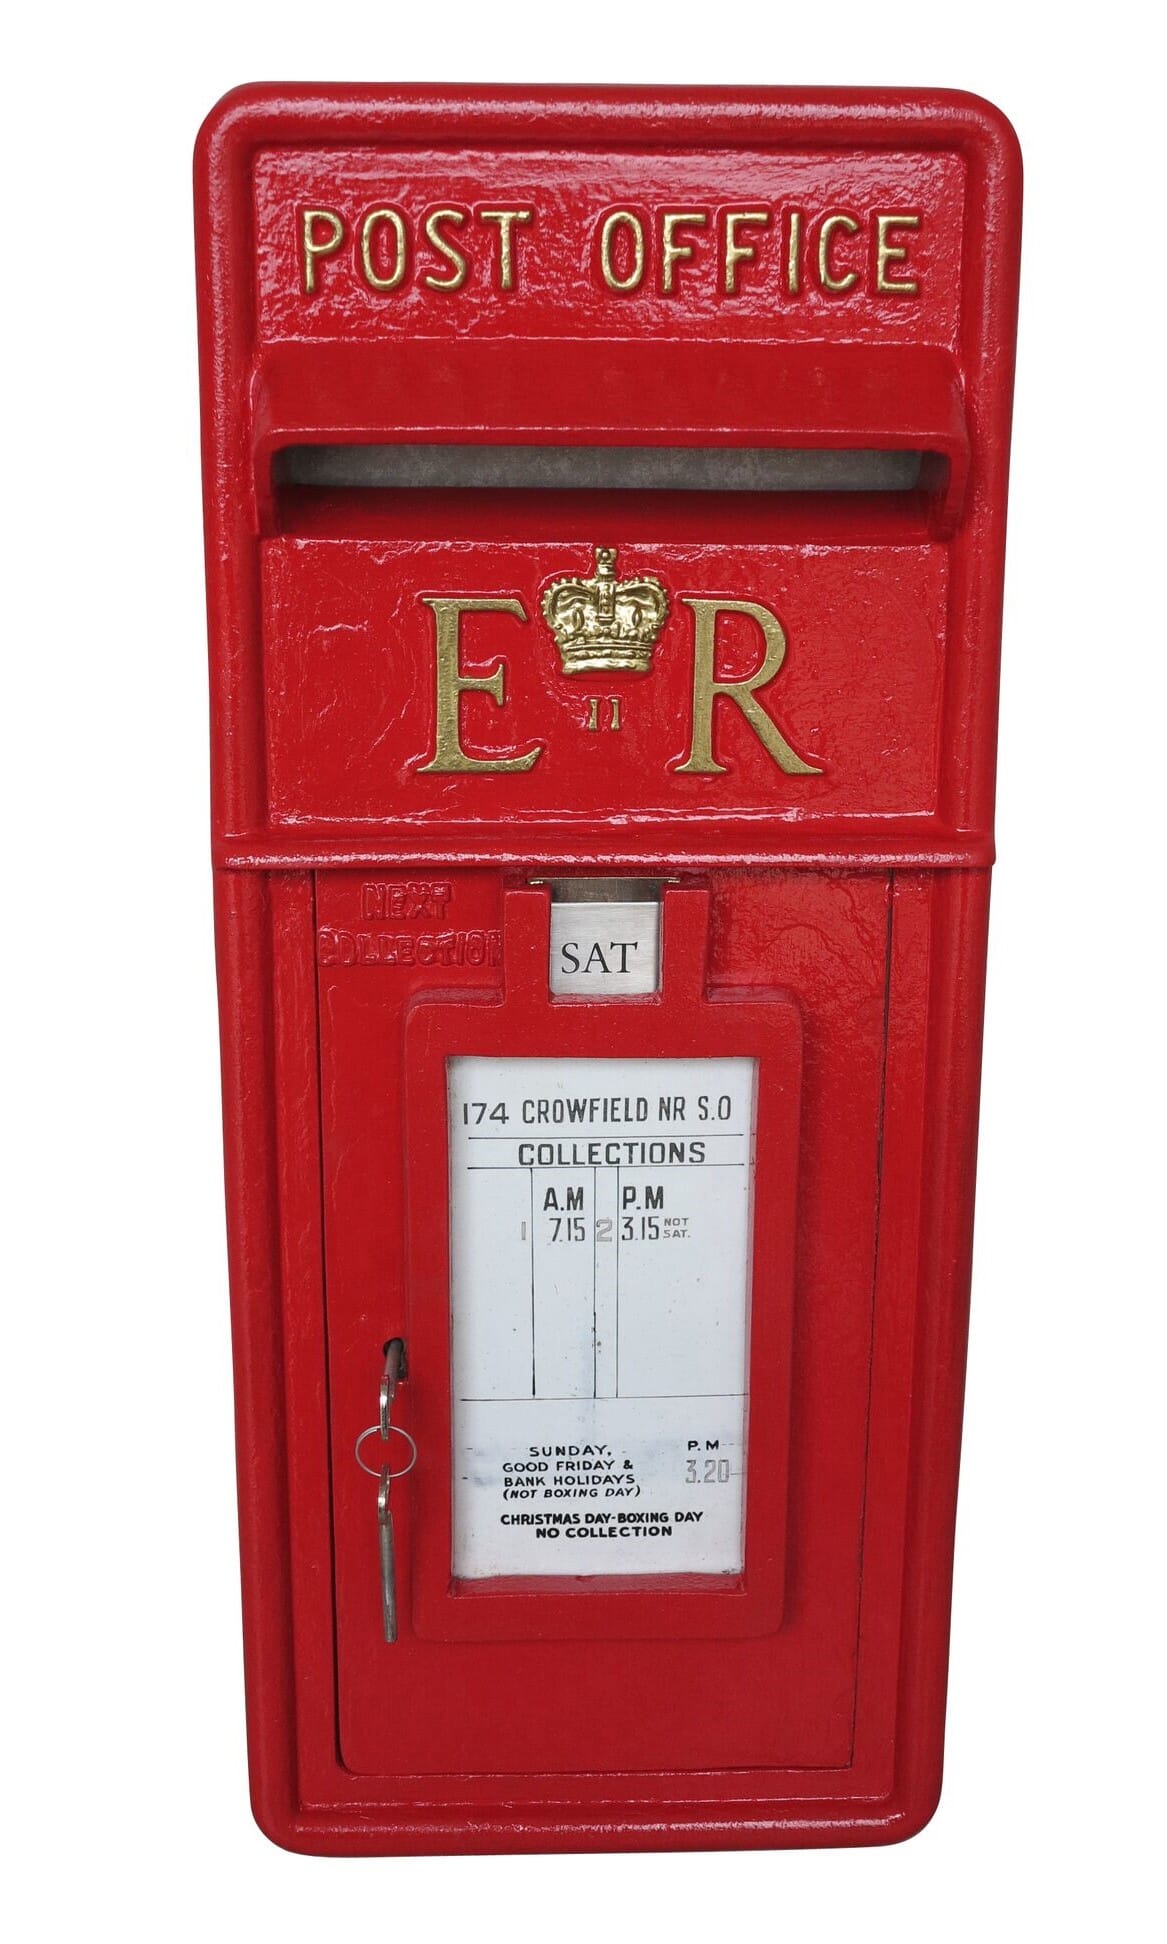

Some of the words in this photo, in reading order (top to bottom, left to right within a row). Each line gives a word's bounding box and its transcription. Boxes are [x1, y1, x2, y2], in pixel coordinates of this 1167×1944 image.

[303, 208, 532, 295] POST
[600, 209, 922, 295] OFFICE
[417, 597, 544, 776] E
[674, 597, 824, 777] R
[360, 882, 451, 921] NEXT
[561, 942, 639, 975] SAT
[462, 1102, 510, 1125] 174
[521, 1097, 649, 1124] CROWFIELD
[658, 1096, 686, 1121] NR
[697, 1095, 732, 1121] S.O
[517, 1141, 706, 1166] COLLECTIONS
[543, 1187, 585, 1212] A.M
[622, 1186, 664, 1210] P.M
[548, 1217, 586, 1242] 7.15
[595, 1218, 613, 1243] 2
[621, 1216, 660, 1242] 3.15
[663, 1217, 690, 1227] NOT
[663, 1228, 692, 1239] SAT.
[529, 1445, 612, 1457] SUNDAY,
[502, 1461, 549, 1473] GOOD
[556, 1460, 616, 1472] FRIDAY
[623, 1459, 634, 1471] &
[685, 1459, 730, 1483] 3.20
[502, 1488, 537, 1500] (NOT
[543, 1487, 599, 1499] BOXING
[605, 1485, 642, 1498] DAY)
[504, 1476, 546, 1487] BANK
[554, 1474, 636, 1486] HOLIDAYS
[500, 1513, 581, 1526] CHRISTMAS
[674, 1511, 704, 1523] DAY
[536, 1527, 560, 1539] NO
[566, 1526, 673, 1539] COLLECTION
